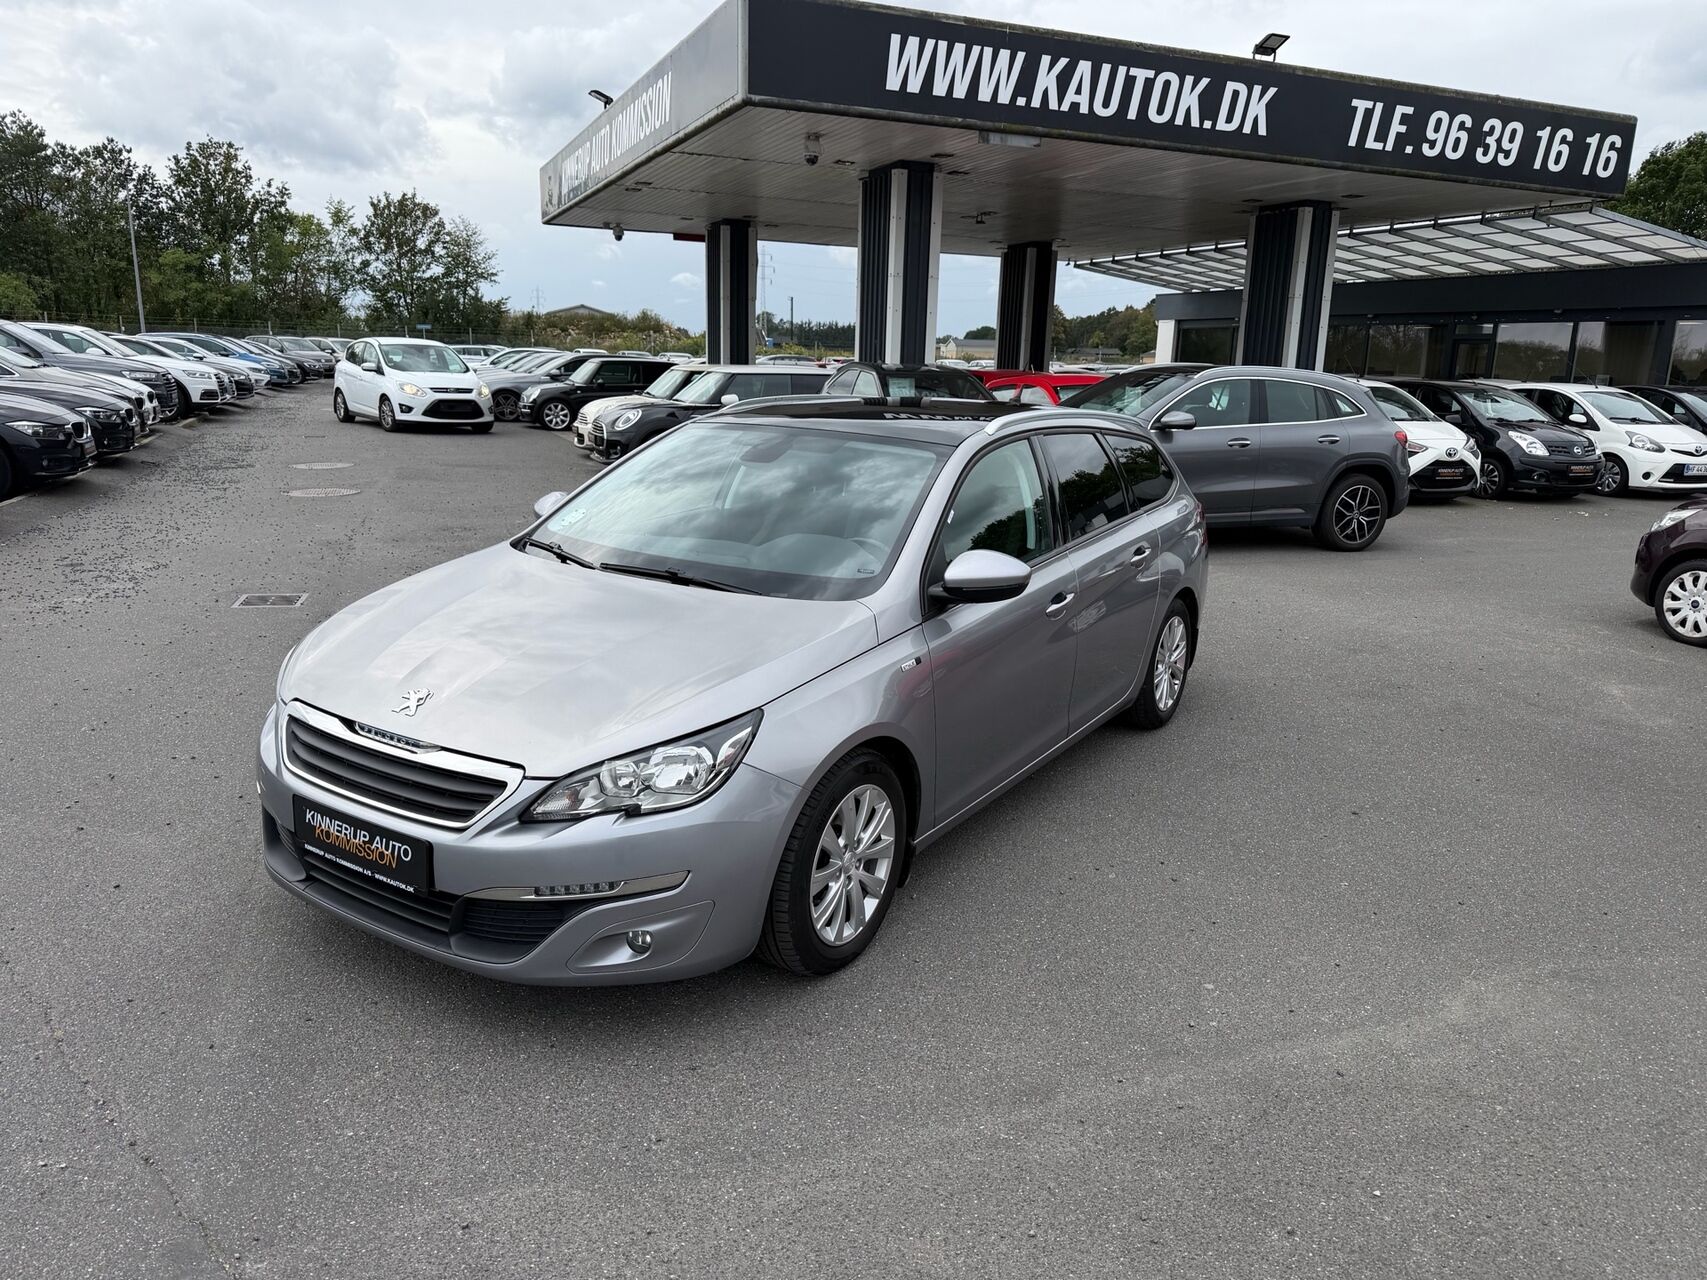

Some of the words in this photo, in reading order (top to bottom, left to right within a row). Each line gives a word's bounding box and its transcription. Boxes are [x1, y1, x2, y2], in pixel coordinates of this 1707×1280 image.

[886, 33, 1278, 136] WWW.KAUTOK.DK
[590, 124, 610, 175] AUTO
[611, 71, 672, 161] KOMMISSION
[1348, 99, 1414, 154] TLF.
[1422, 110, 1472, 160] 96
[1475, 118, 1524, 167] 39
[1533, 126, 1573, 172] 16
[1582, 132, 1622, 178] 16
[305, 808, 370, 844] KINNERUP
[371, 835, 412, 862] AUTO
[315, 826, 397, 869] KOMMISSION
[324, 852, 336, 862] AUTO
